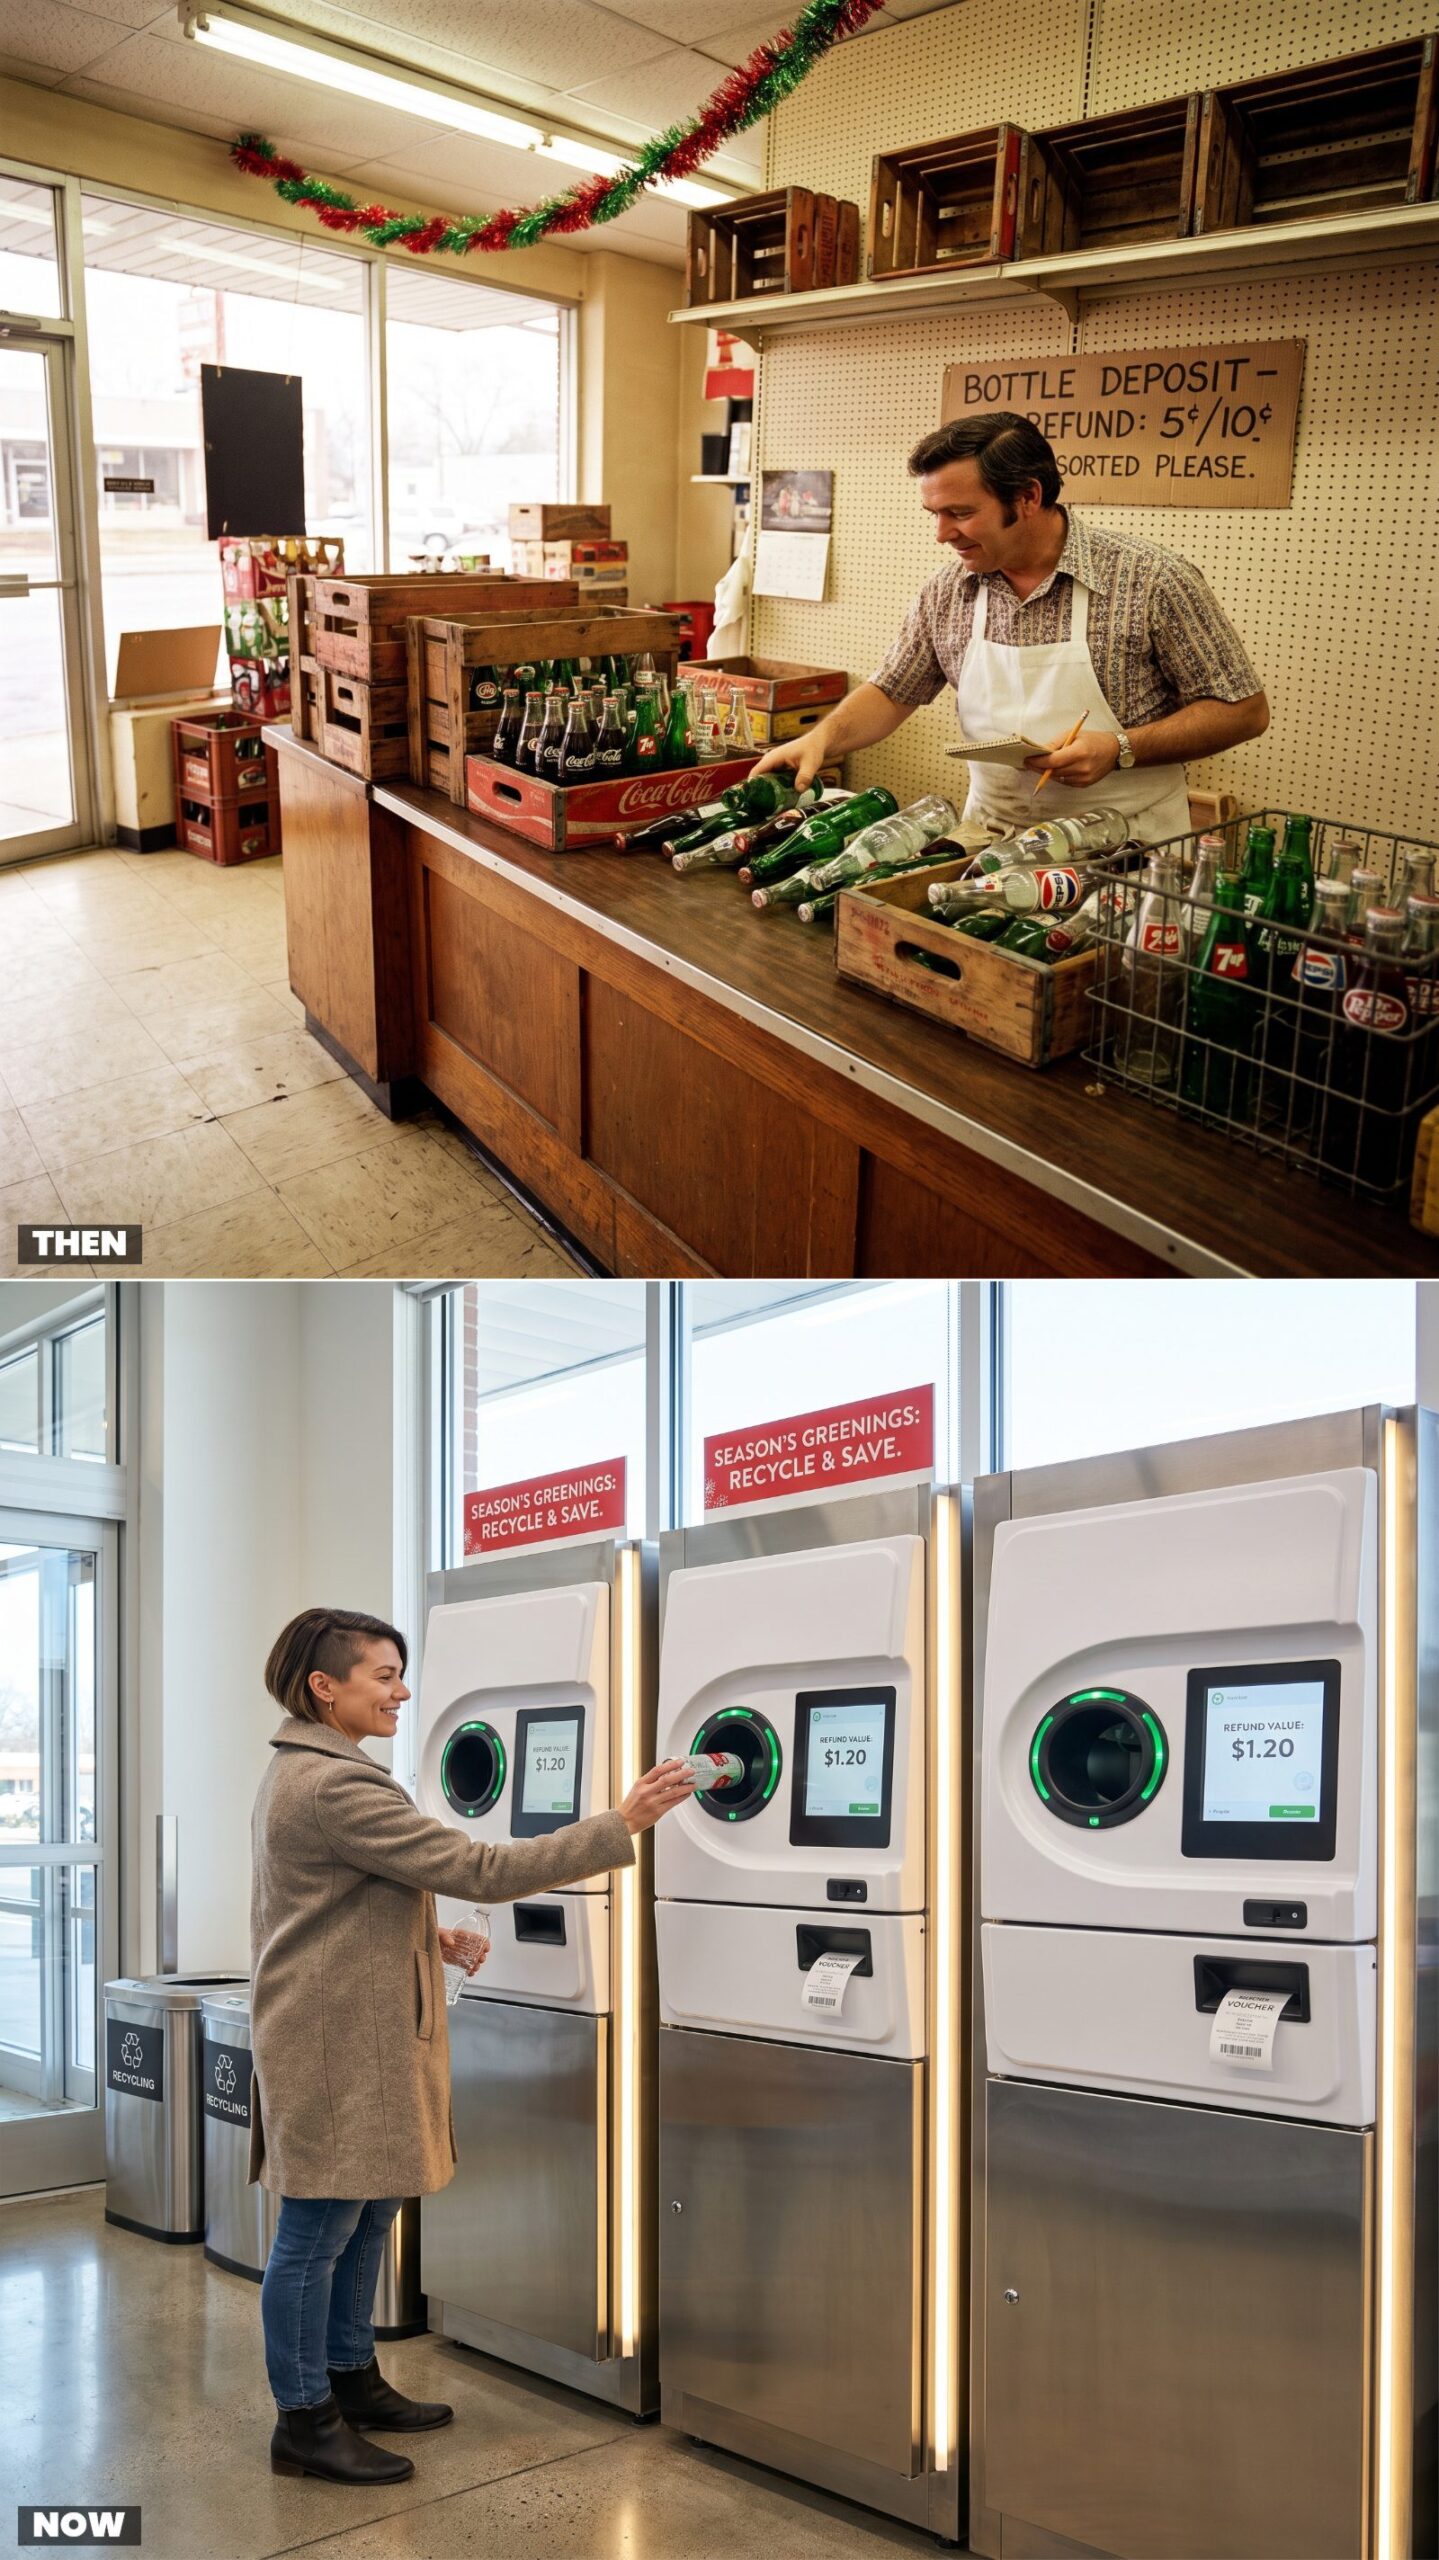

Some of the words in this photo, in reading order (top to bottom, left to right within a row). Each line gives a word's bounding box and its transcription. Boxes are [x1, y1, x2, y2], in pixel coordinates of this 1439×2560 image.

[964, 369, 1076, 404] BOTTLE
[1155, 454, 1256, 478] PLEASE.
[618, 767, 718, 815] Coca-Cola
[1216, 947, 1246, 971] 7up
[1348, 995, 1402, 1025] Pepper
[1366, 996, 1392, 1012] Dr
[714, 1432, 797, 1467] SEASON'S
[801, 1405, 920, 1448] GREENINGS:
[729, 1453, 815, 1490] RECYCLE
[821, 1450, 836, 1471] &
[841, 1436, 902, 1468] SAVE.
[471, 1492, 531, 1520] SEASON'S
[533, 1474, 616, 1506] GREENINGS:
[482, 1511, 543, 1539] RECYCLE
[547, 1509, 557, 1526] &
[561, 1499, 603, 1524] SAVE.
[1223, 1722, 1265, 1732] REFUND
[1267, 1720, 1305, 1730] VALUE:
[820, 1736, 847, 1744] REFUND
[1231, 1738, 1295, 1762] $1.20
[535, 1756, 566, 1773] $1.20
[824, 1748, 867, 1768] $1.20
[1227, 2000, 1276, 2012] VOUCHER
[112, 2070, 155, 2090] RECYCLING
[206, 2092, 248, 2117] RECYCLING
